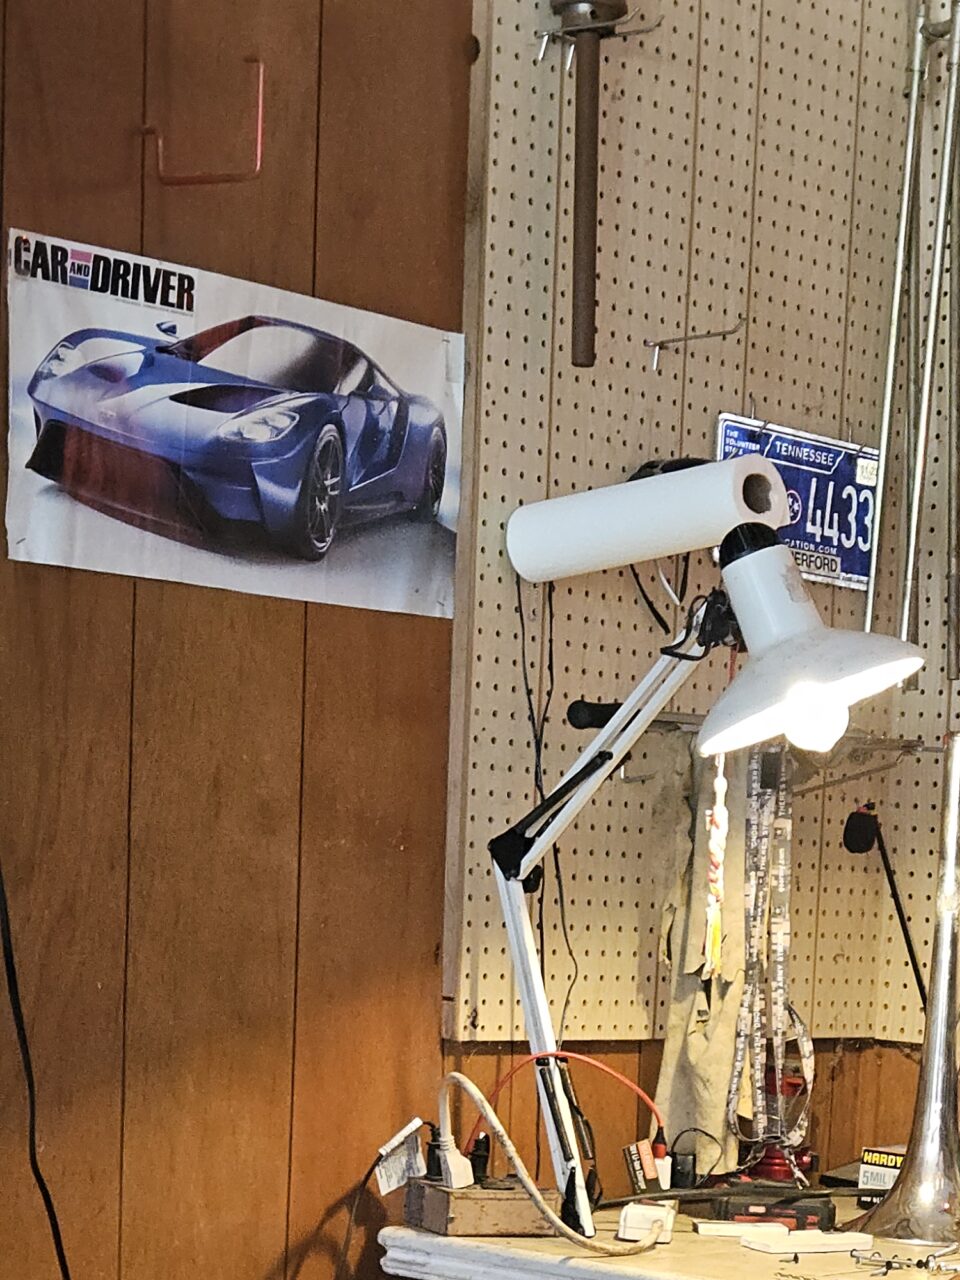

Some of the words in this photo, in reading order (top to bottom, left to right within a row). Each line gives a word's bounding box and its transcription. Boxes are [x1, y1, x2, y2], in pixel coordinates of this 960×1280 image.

[14, 236, 69, 285] CAR
[69, 262, 90, 277] AND
[90, 254, 195, 312] DRIVER
[775, 441, 835, 466] TENNESSEE
[806, 477, 874, 552] 4433
[792, 551, 838, 573] ERFORD
[863, 1151, 904, 1168] HARDY
